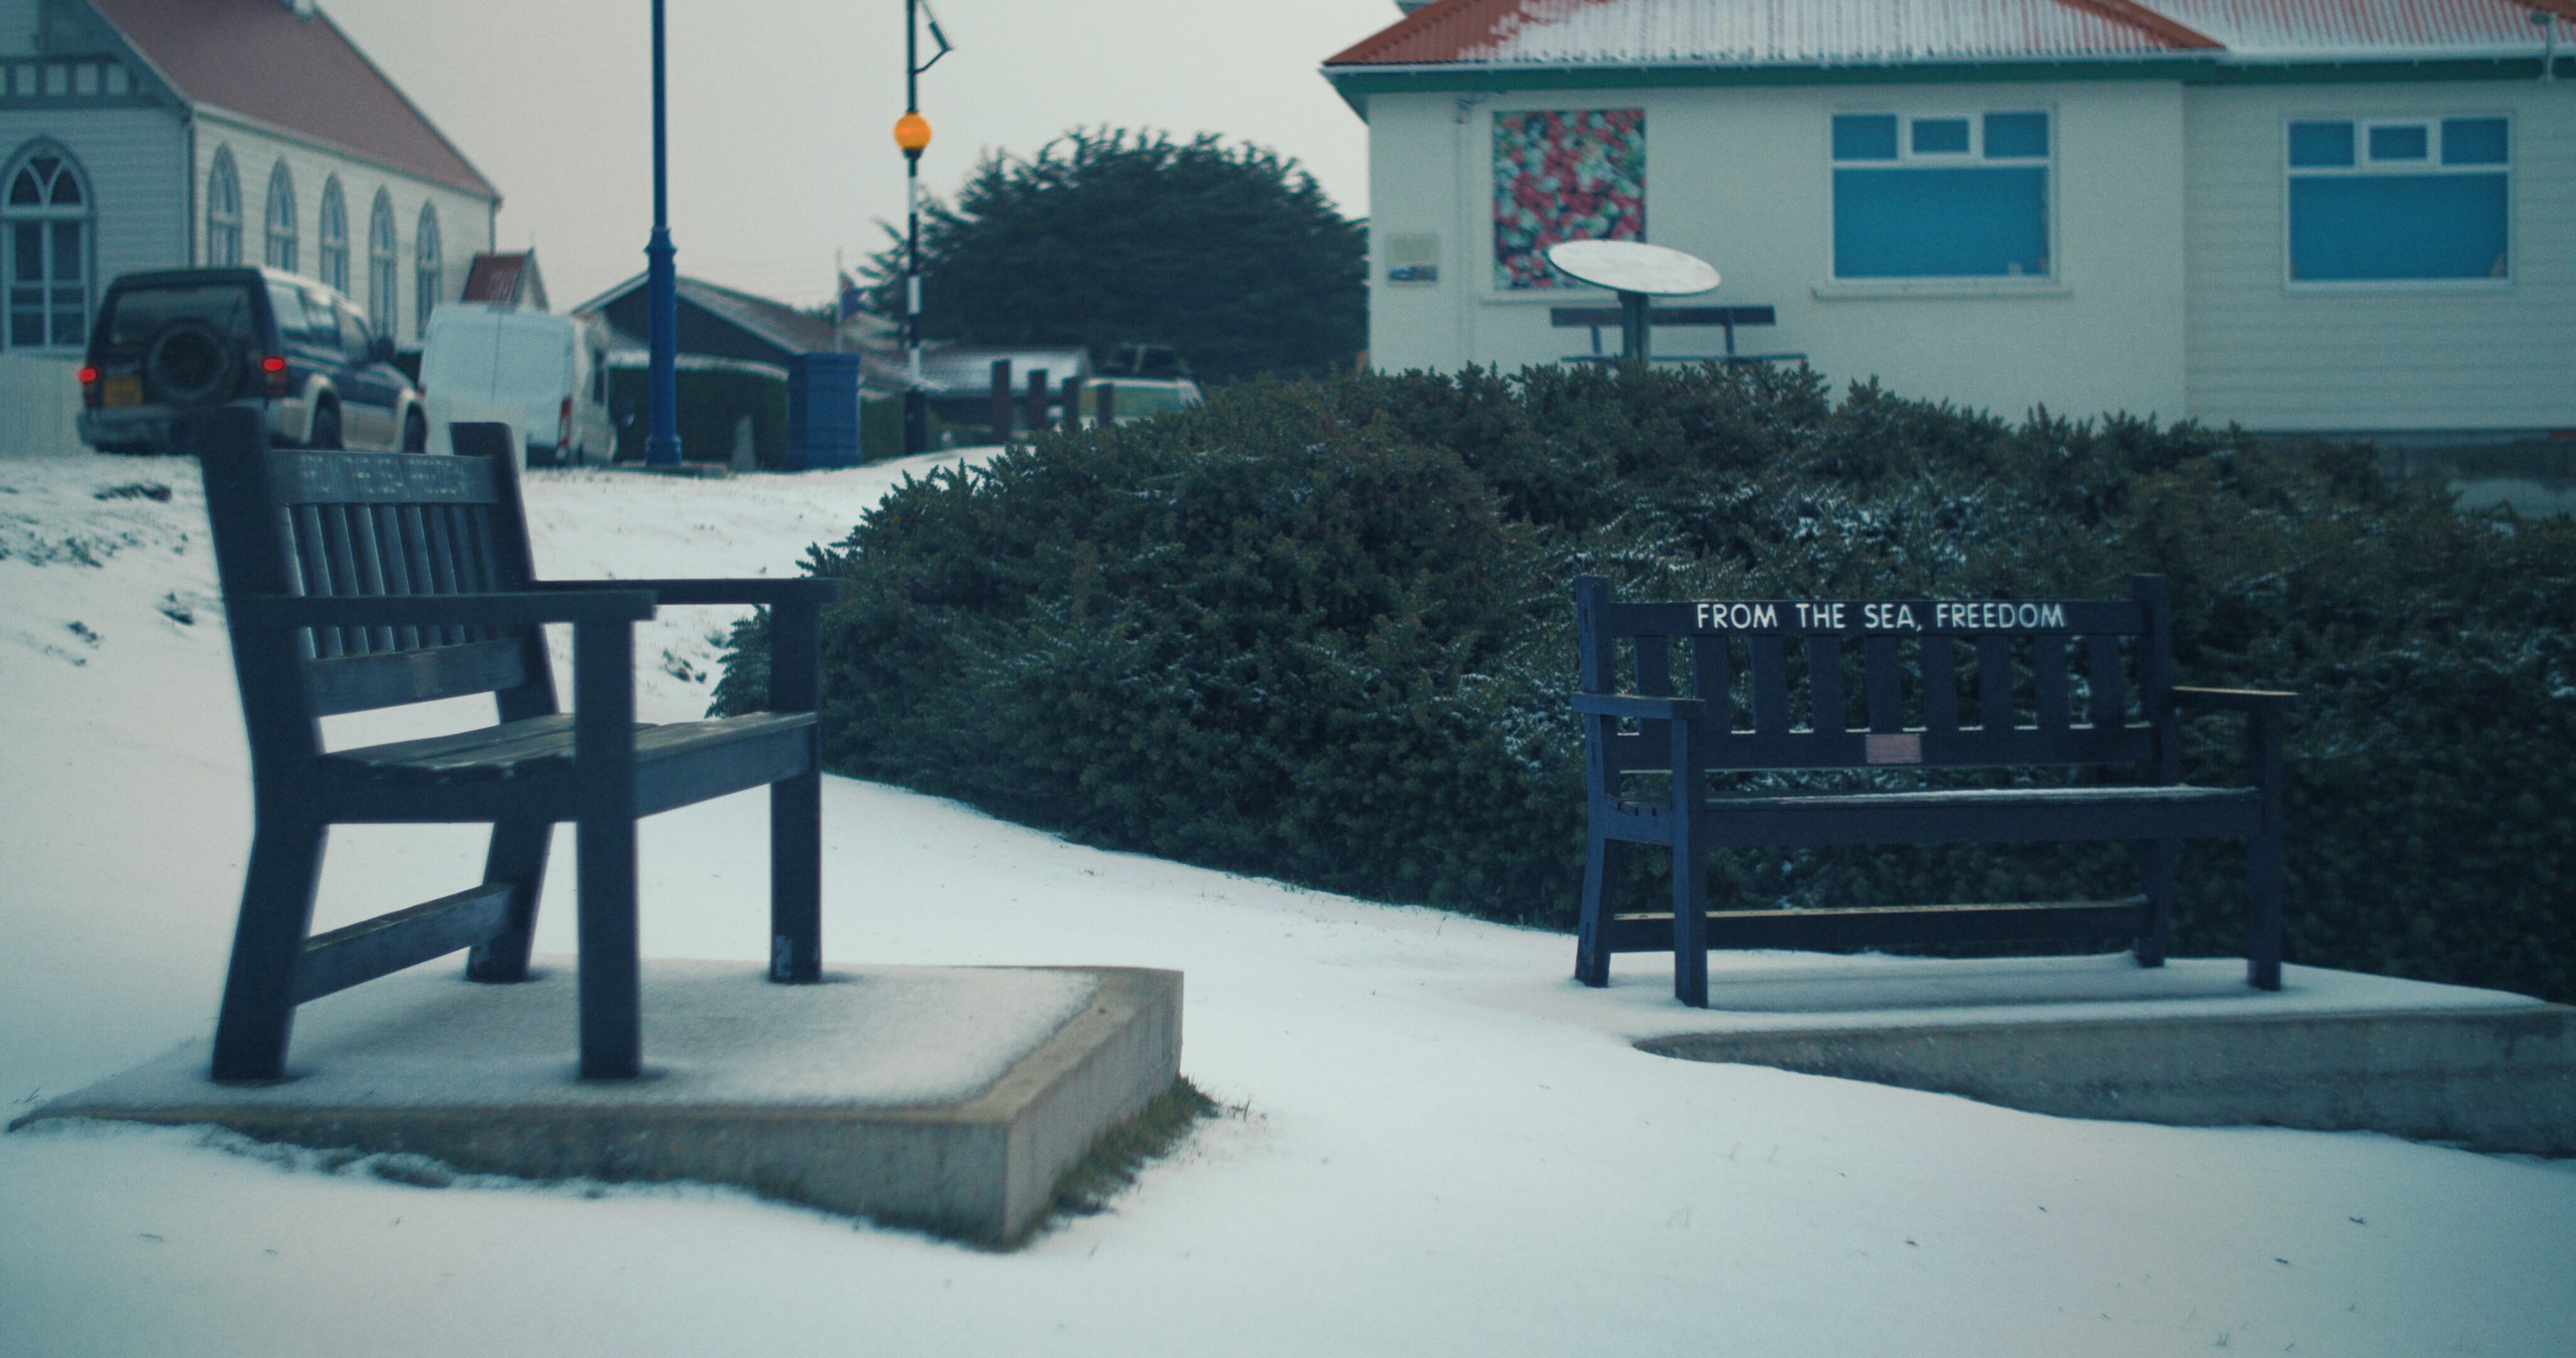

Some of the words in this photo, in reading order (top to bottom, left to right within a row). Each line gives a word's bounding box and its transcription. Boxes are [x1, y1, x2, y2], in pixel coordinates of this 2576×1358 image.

[1697, 603, 1779, 629] FROM
[1795, 603, 1846, 629] THE
[1864, 603, 1923, 632] SEA,
[1936, 602, 2065, 629] FREEDOM
